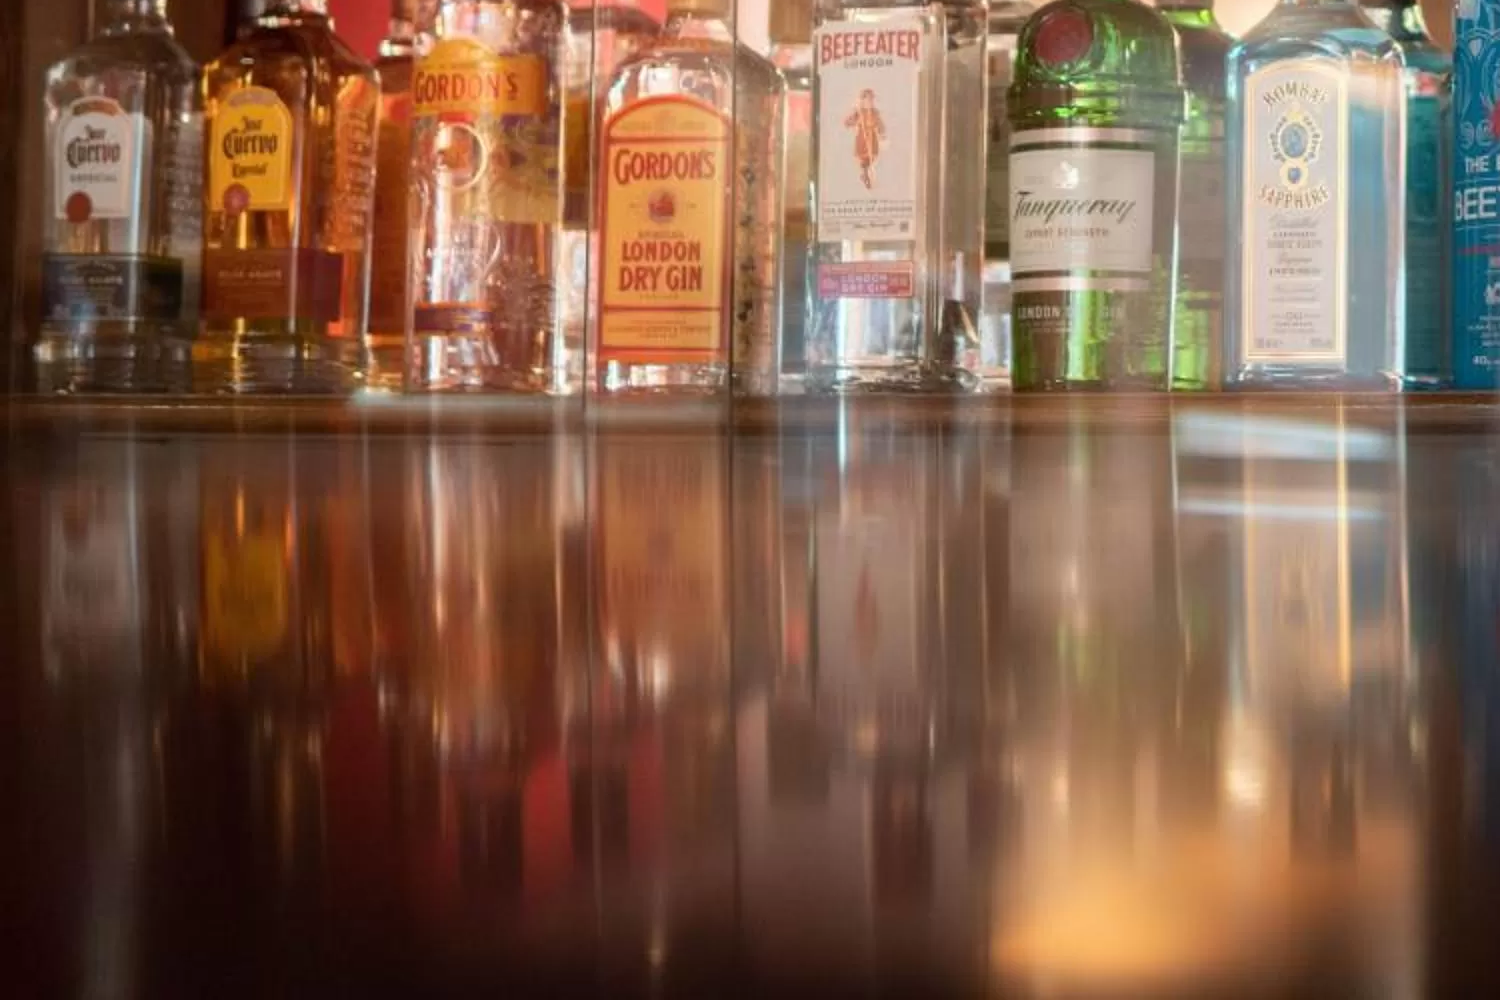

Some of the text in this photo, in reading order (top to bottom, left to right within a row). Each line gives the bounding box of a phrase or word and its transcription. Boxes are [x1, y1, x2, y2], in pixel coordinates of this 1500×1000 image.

[821, 29, 921, 65] BEEFEATER
[1465, 155, 1490, 173] THE
[1014, 190, 1136, 225] Tanqueray
[621, 239, 701, 262] LONDON
[618, 264, 704, 292] DRY GIN
